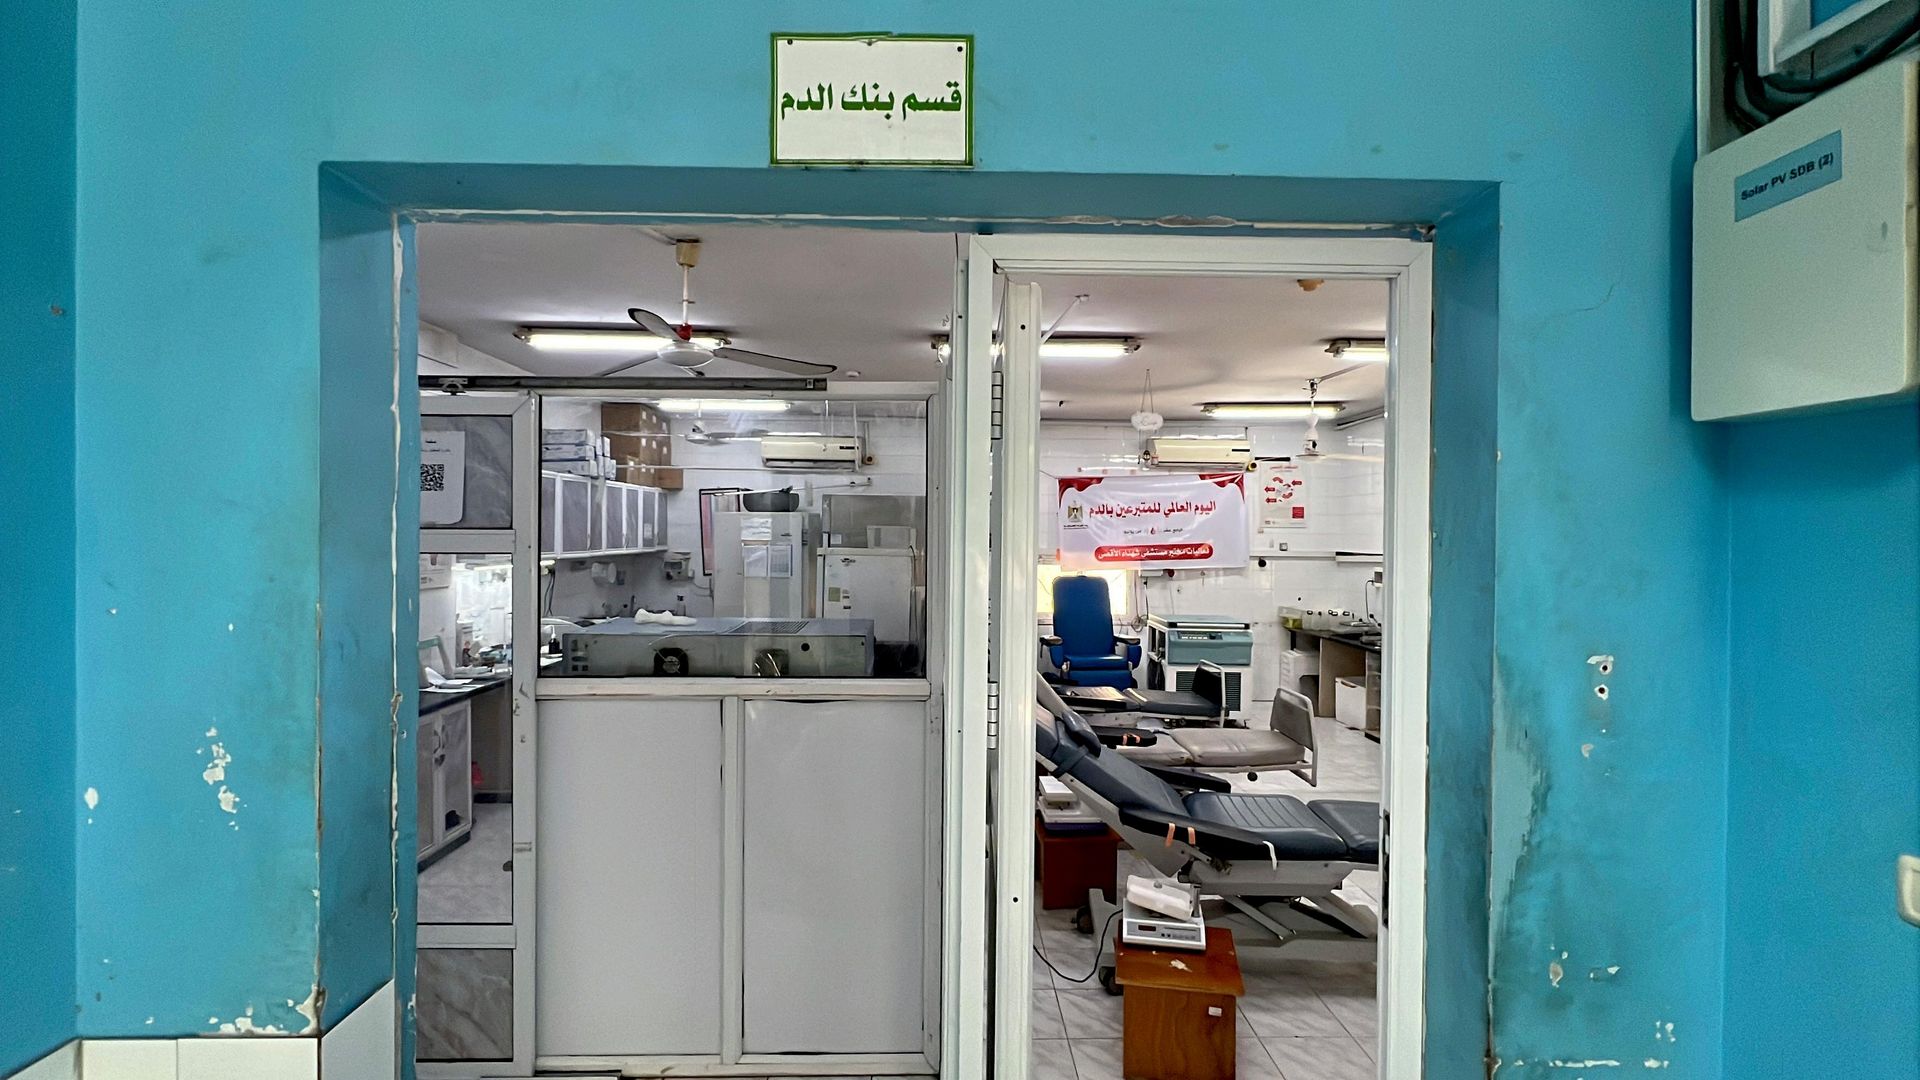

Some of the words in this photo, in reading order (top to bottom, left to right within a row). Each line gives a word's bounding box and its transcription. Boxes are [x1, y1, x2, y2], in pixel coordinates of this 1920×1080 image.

[781, 82, 834, 120] الدم
[841, 82, 895, 120] بنك
[902, 80, 962, 121] قسم
[1741, 182, 1769, 200] Solar
[1771, 173, 1787, 187] PV
[1789, 160, 1815, 180] SDB
[1818, 152, 1834, 170] (2)
[1089, 503, 1114, 518] بالدم
[1115, 499, 1161, 518] للمتبرعين
[1163, 501, 1191, 518] العالمي
[1194, 500, 1216, 515] اليوم
